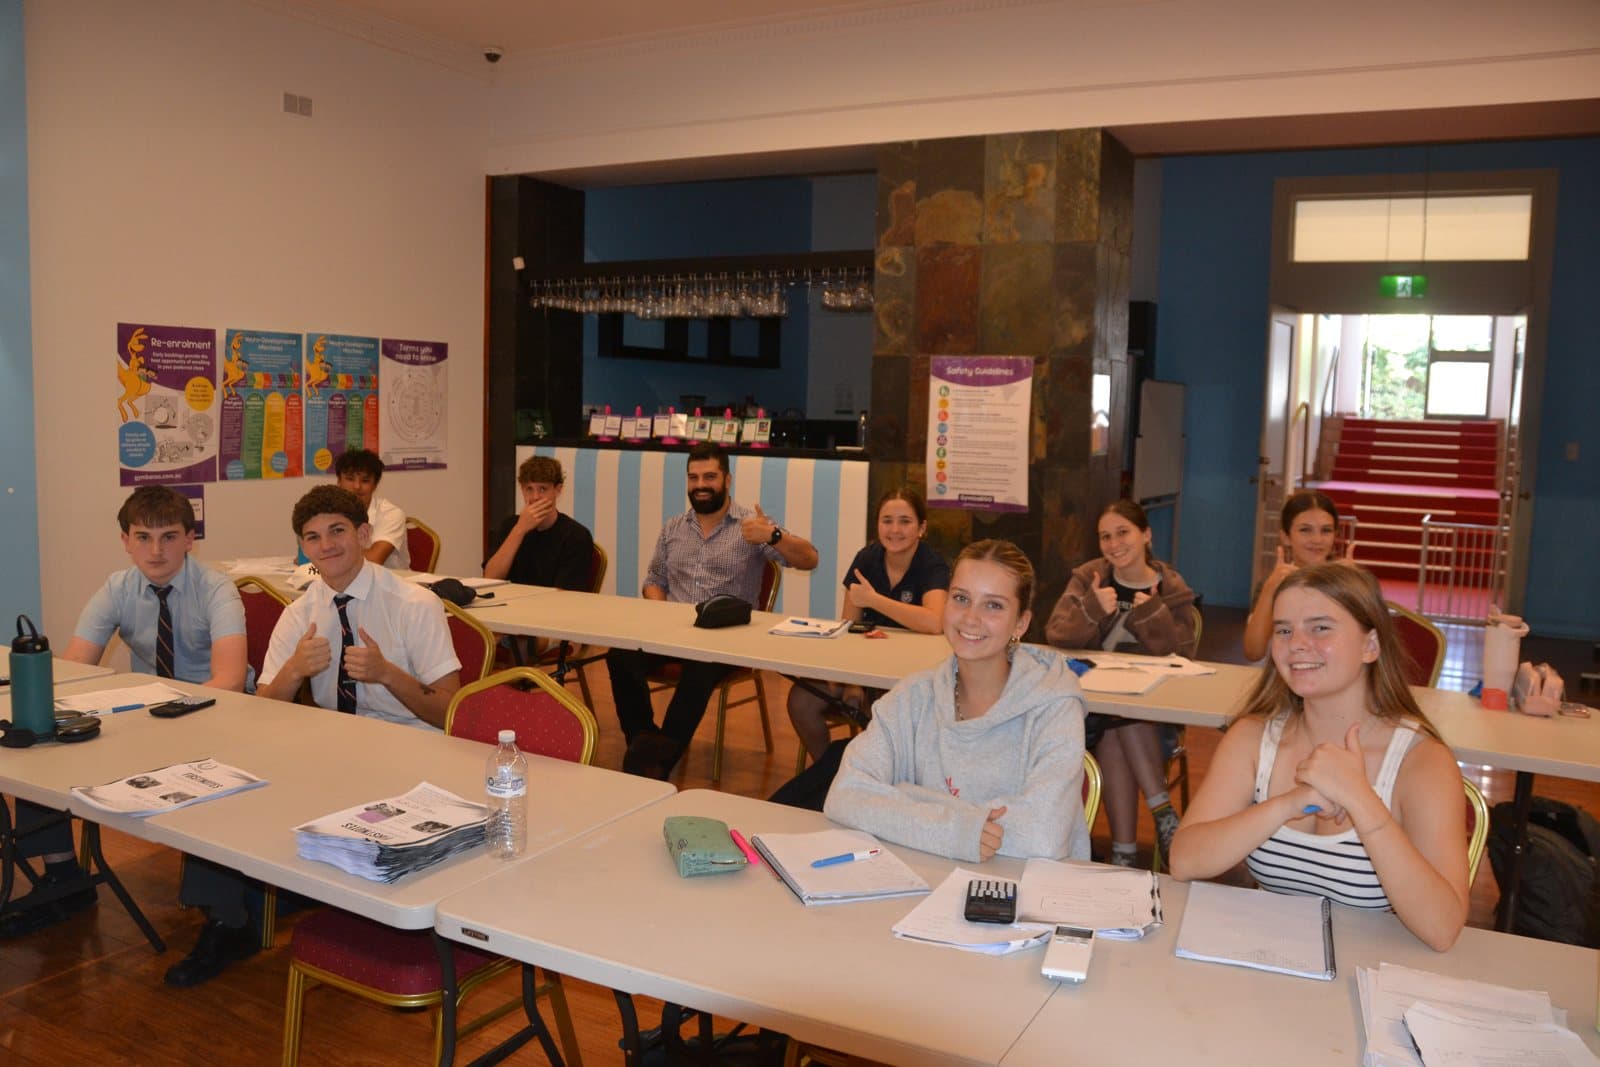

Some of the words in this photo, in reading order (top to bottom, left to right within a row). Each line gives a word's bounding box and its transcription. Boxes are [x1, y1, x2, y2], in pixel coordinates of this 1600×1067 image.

[151, 337, 211, 350] Re-enrolment
[946, 365, 974, 377] Safety
[975, 366, 1014, 377] Guidelines
